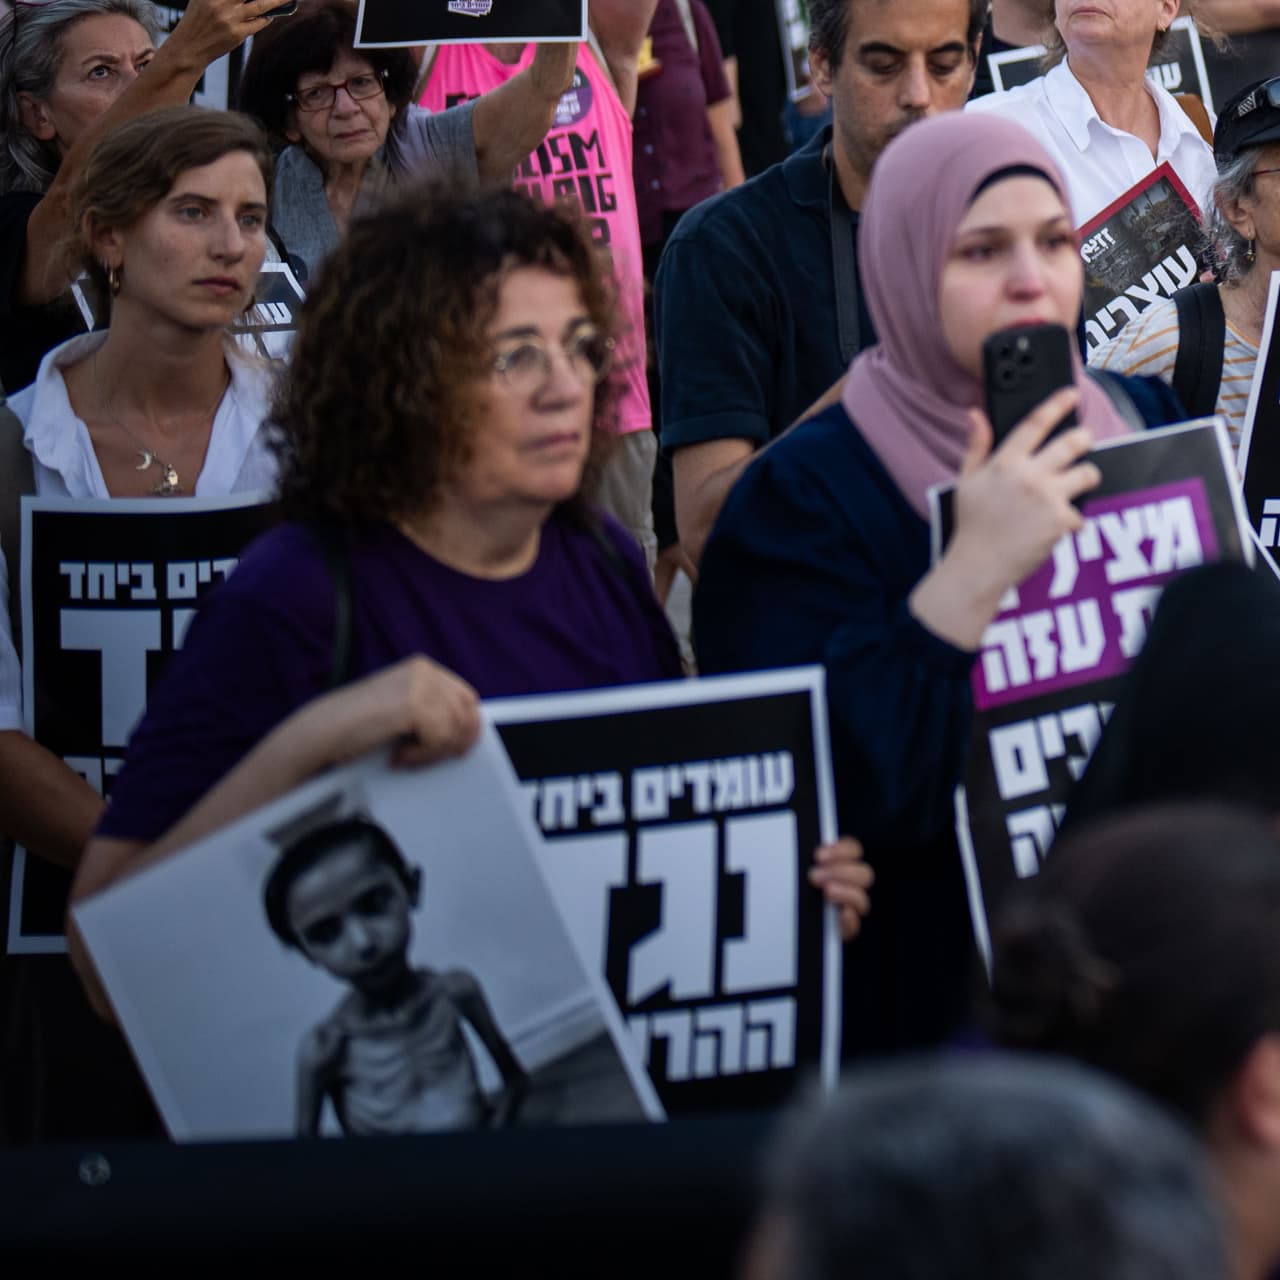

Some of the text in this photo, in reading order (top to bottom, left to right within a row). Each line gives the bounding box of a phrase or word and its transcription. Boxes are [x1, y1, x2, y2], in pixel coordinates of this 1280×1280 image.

[59, 560, 157, 600] ביחד
[981, 597, 1106, 693] עזה
[631, 750, 796, 822] עומדים
